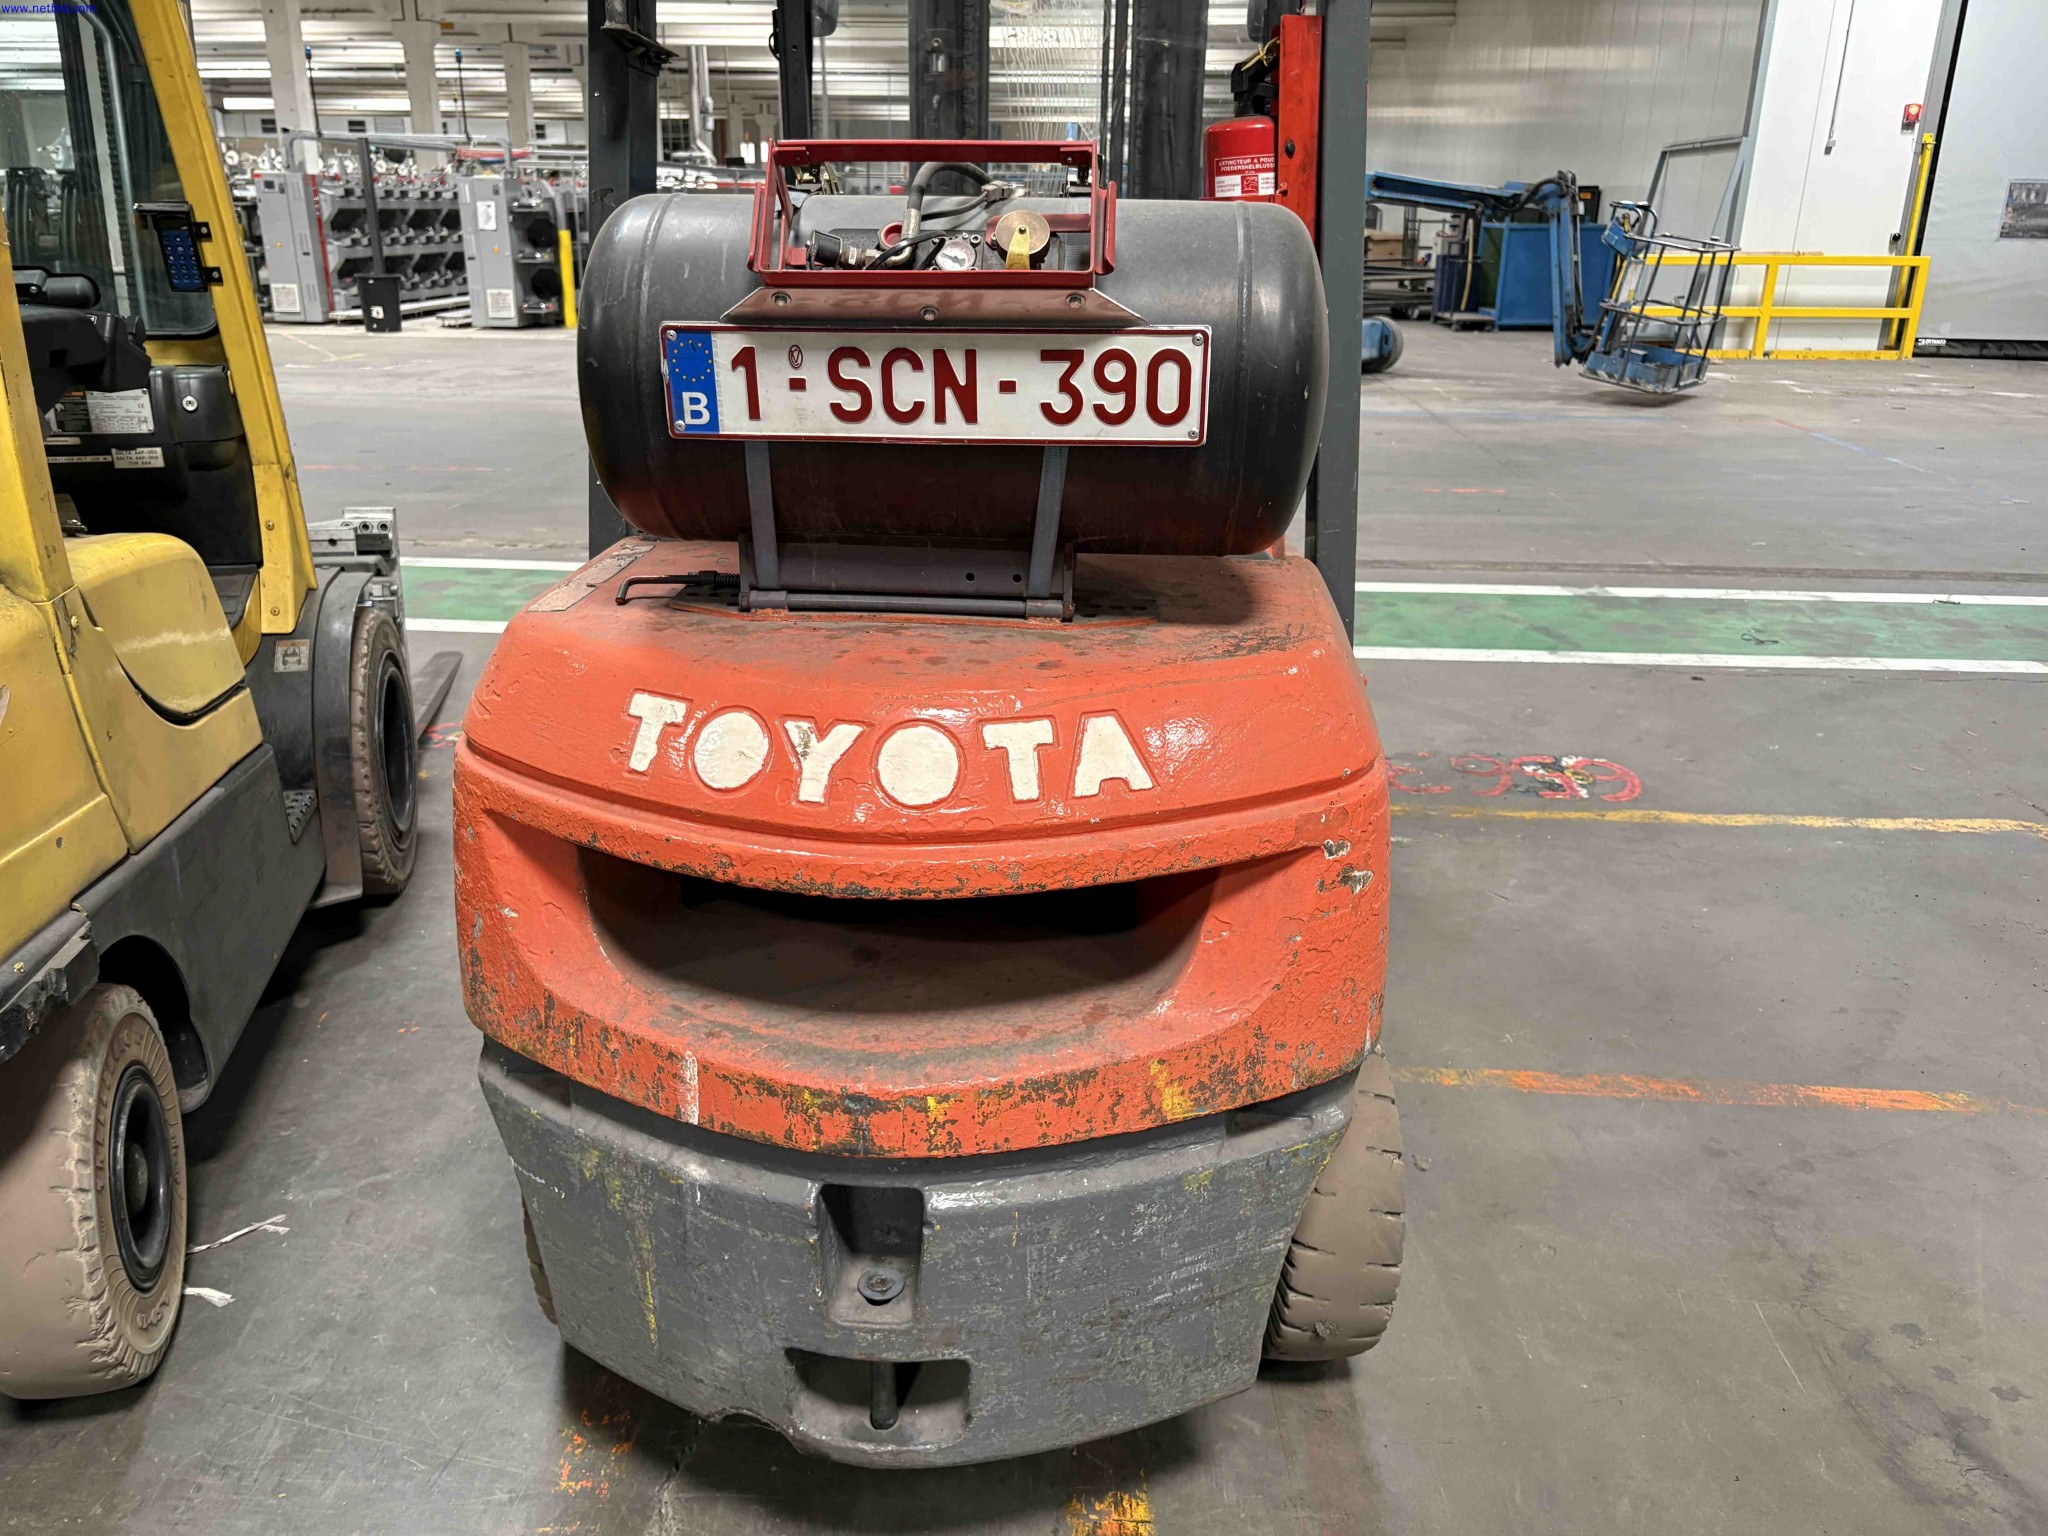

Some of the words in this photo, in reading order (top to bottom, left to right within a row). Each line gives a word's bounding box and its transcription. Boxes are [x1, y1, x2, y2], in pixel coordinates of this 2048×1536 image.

[1219, 158, 1252, 167] EXTINCTEUR
[681, 391, 710, 425] B
[731, 346, 1192, 426] 1-SCN-390
[628, 692, 1155, 806] TOYOTA
